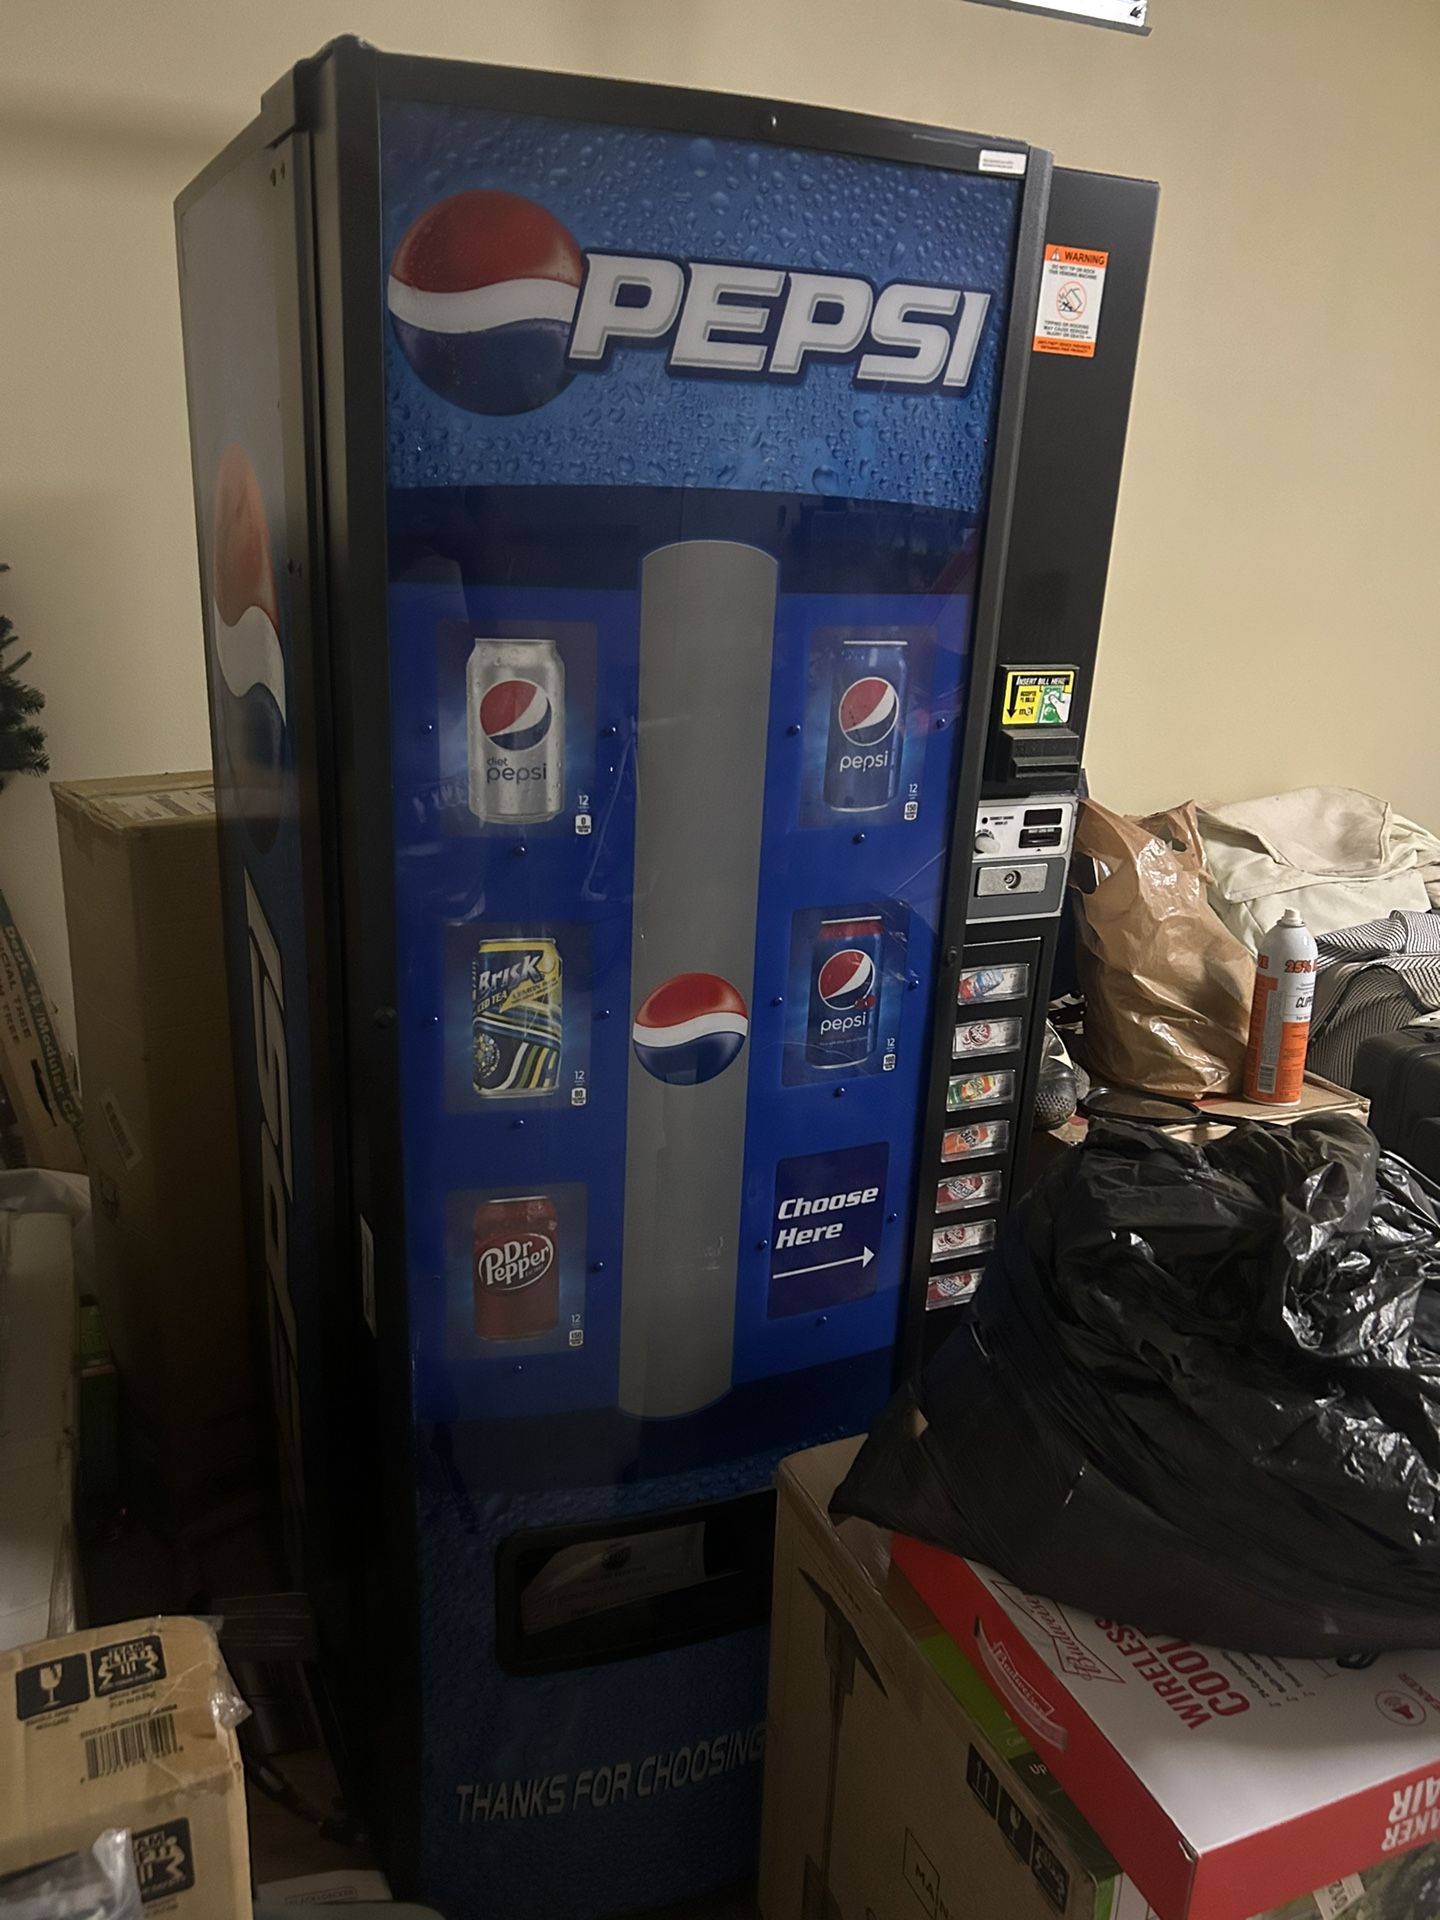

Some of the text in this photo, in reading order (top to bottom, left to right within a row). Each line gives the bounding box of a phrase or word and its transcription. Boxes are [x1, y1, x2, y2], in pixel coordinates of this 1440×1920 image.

[1064, 251, 1105, 266] WARNING
[567, 252, 991, 388] PEPSI
[1016, 676, 1038, 686] INSERT
[1038, 677, 1050, 685] BILL
[487, 757, 509, 766] diet
[840, 750, 889, 773] pepsi
[486, 763, 547, 785] pepsi
[578, 794, 590, 806] 12
[909, 783, 919, 794] 12
[1284, 959, 1311, 974] 25%
[819, 1012, 868, 1036] pepsi
[887, 1038, 896, 1047] 12
[575, 1071, 585, 1081] 12
[777, 1187, 880, 1221] Choose
[775, 1222, 844, 1250] Here
[503, 1240, 534, 1265] Dr
[480, 1246, 550, 1286] Pepper
[570, 1313, 581, 1324] 12
[1023, 1594, 1103, 1682] Budweise
[1095, 1617, 1213, 1730] WIRELESS
[1136, 1622, 1251, 1717] COOL
[455, 1720, 768, 1824] THANKS FOR CHOOSING
